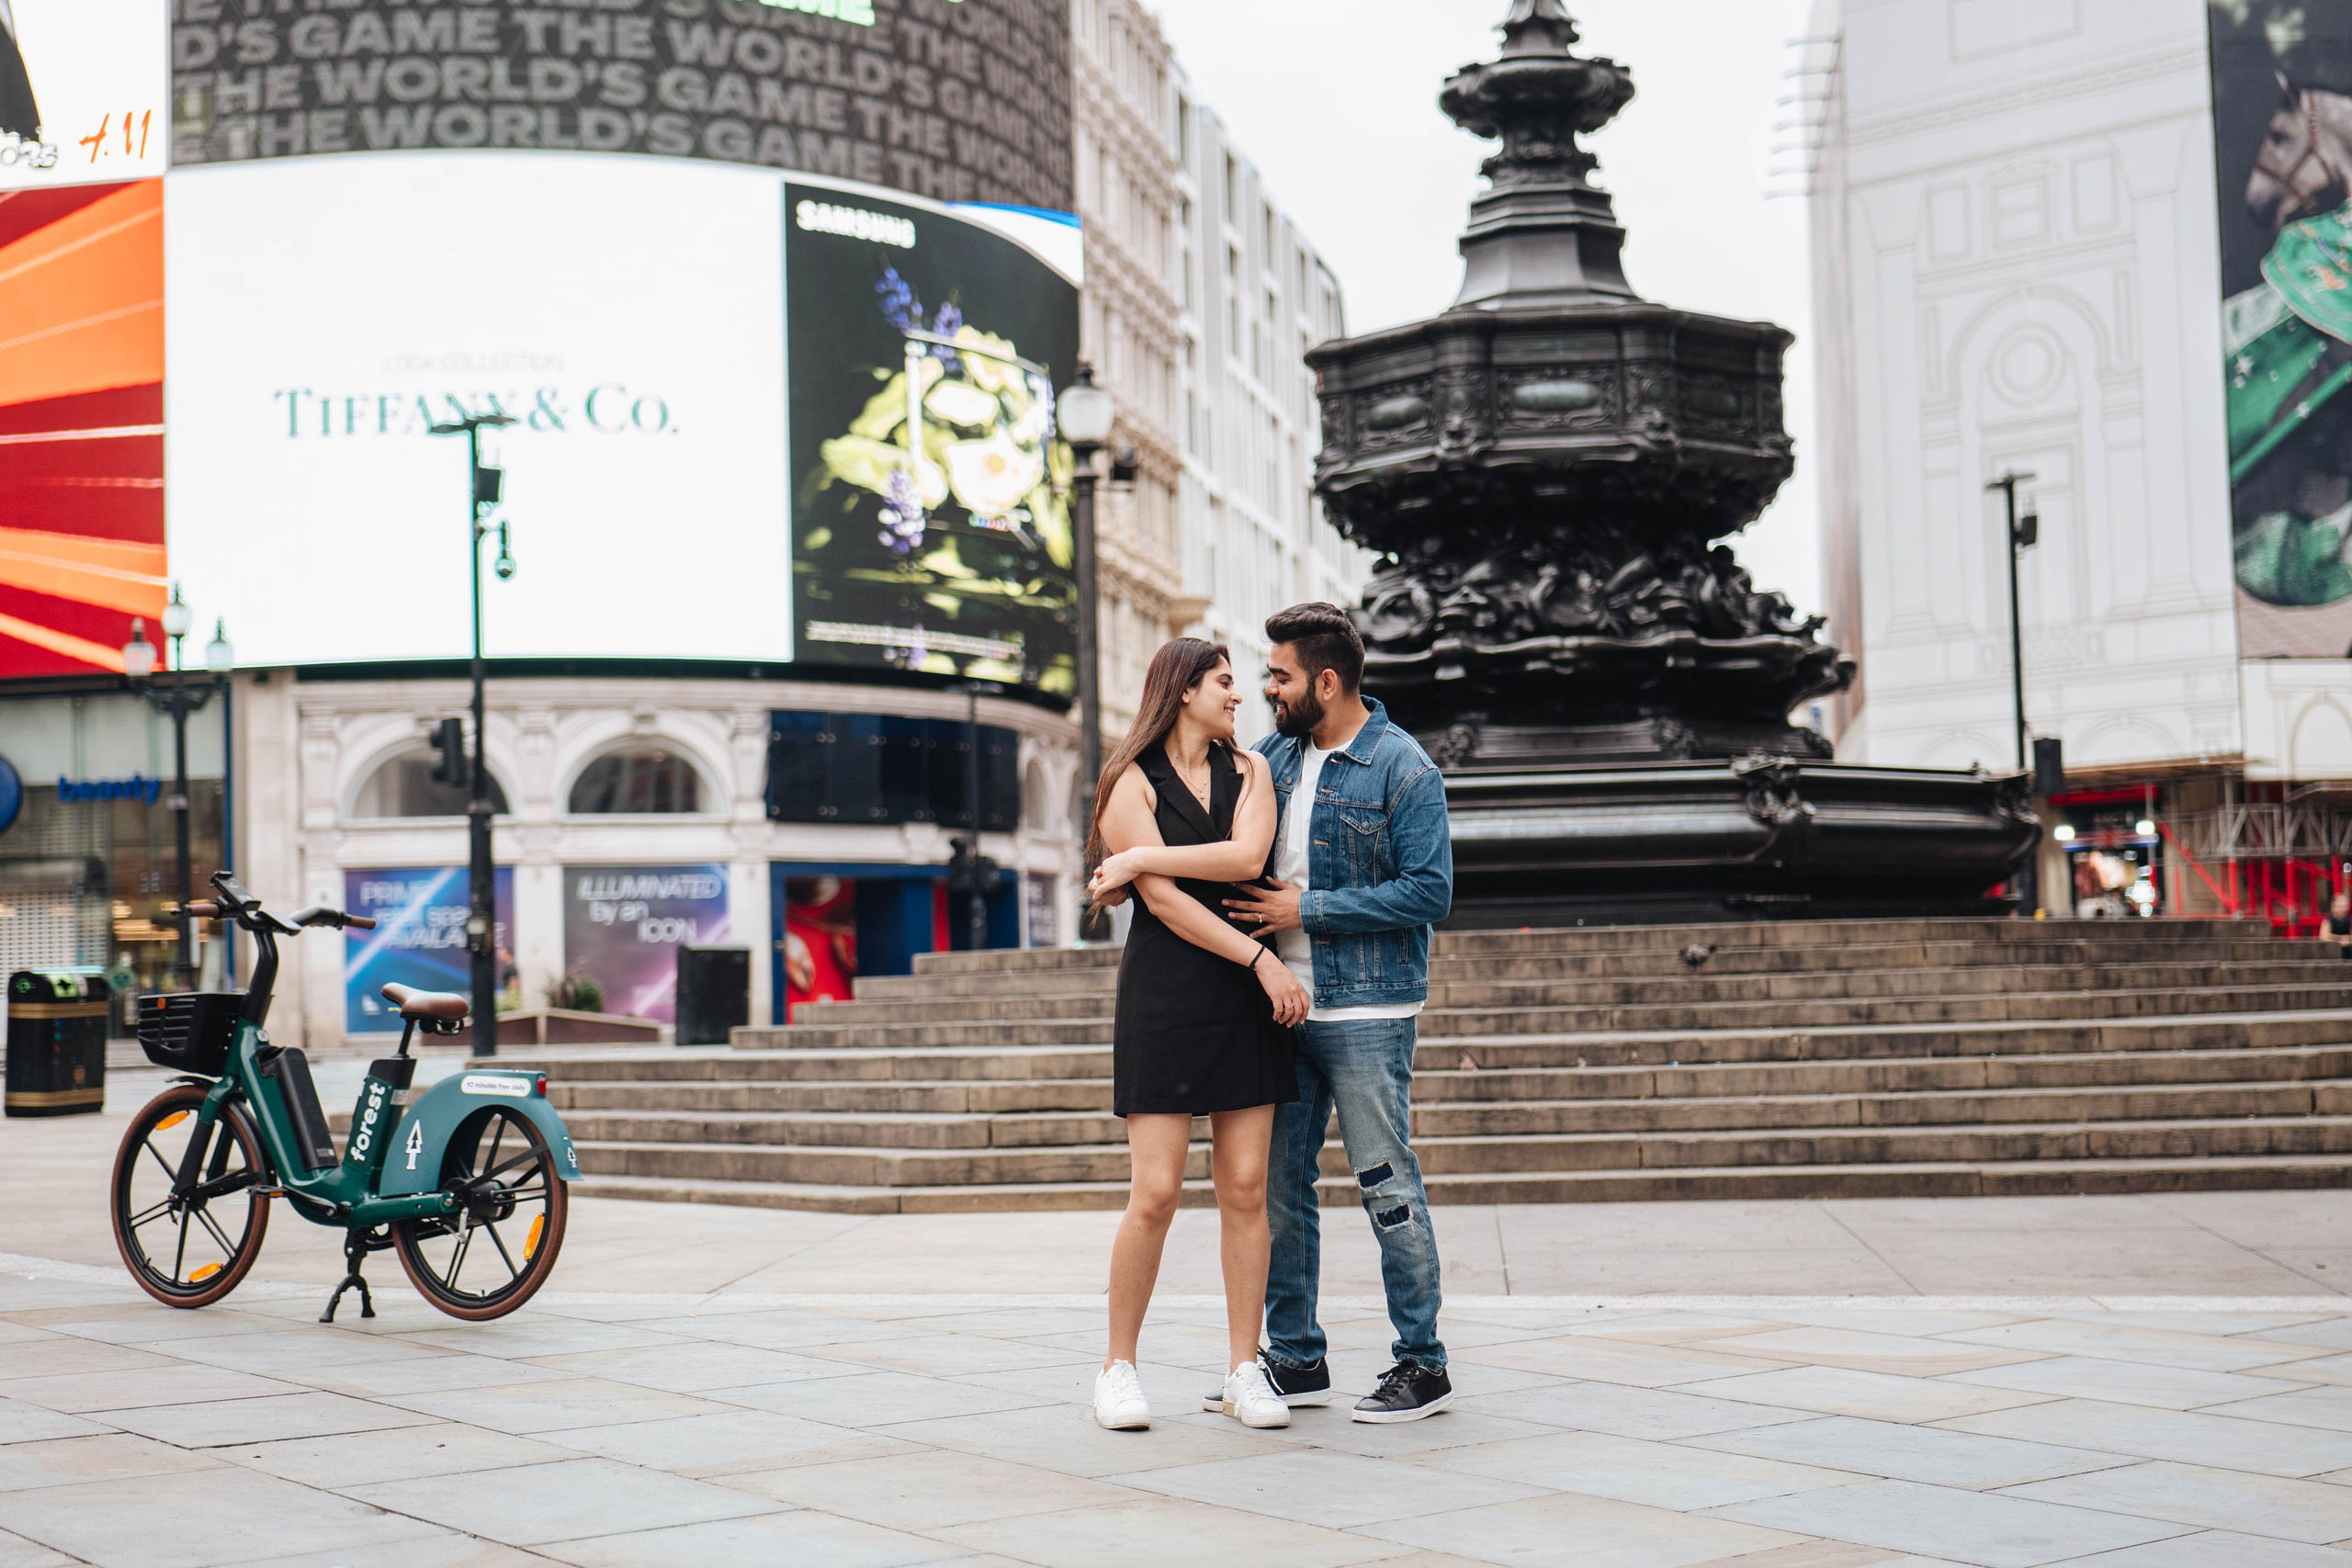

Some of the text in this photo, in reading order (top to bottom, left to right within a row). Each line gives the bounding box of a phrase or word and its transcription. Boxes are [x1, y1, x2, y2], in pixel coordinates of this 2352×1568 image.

[288, 8, 501, 59] GAME
[512, 8, 655, 60] THE
[663, 20, 933, 108] WORLD'S
[173, 64, 302, 118] THE
[314, 56, 647, 107] WORLD'S
[656, 65, 847, 130] GAME
[852, 95, 951, 160] THE
[362, 104, 695, 155] WORLD'S
[703, 117, 885, 184] GAME
[797, 200, 916, 249] SAMSUNG
[526, 384, 570, 432] &
[58, 774, 160, 806] beauty
[576, 874, 722, 900] ILLUMINATED
[619, 900, 650, 922] an
[637, 917, 697, 943] ICON
[511, 1083, 526, 1092] daily
[350, 1082, 386, 1162] forest
